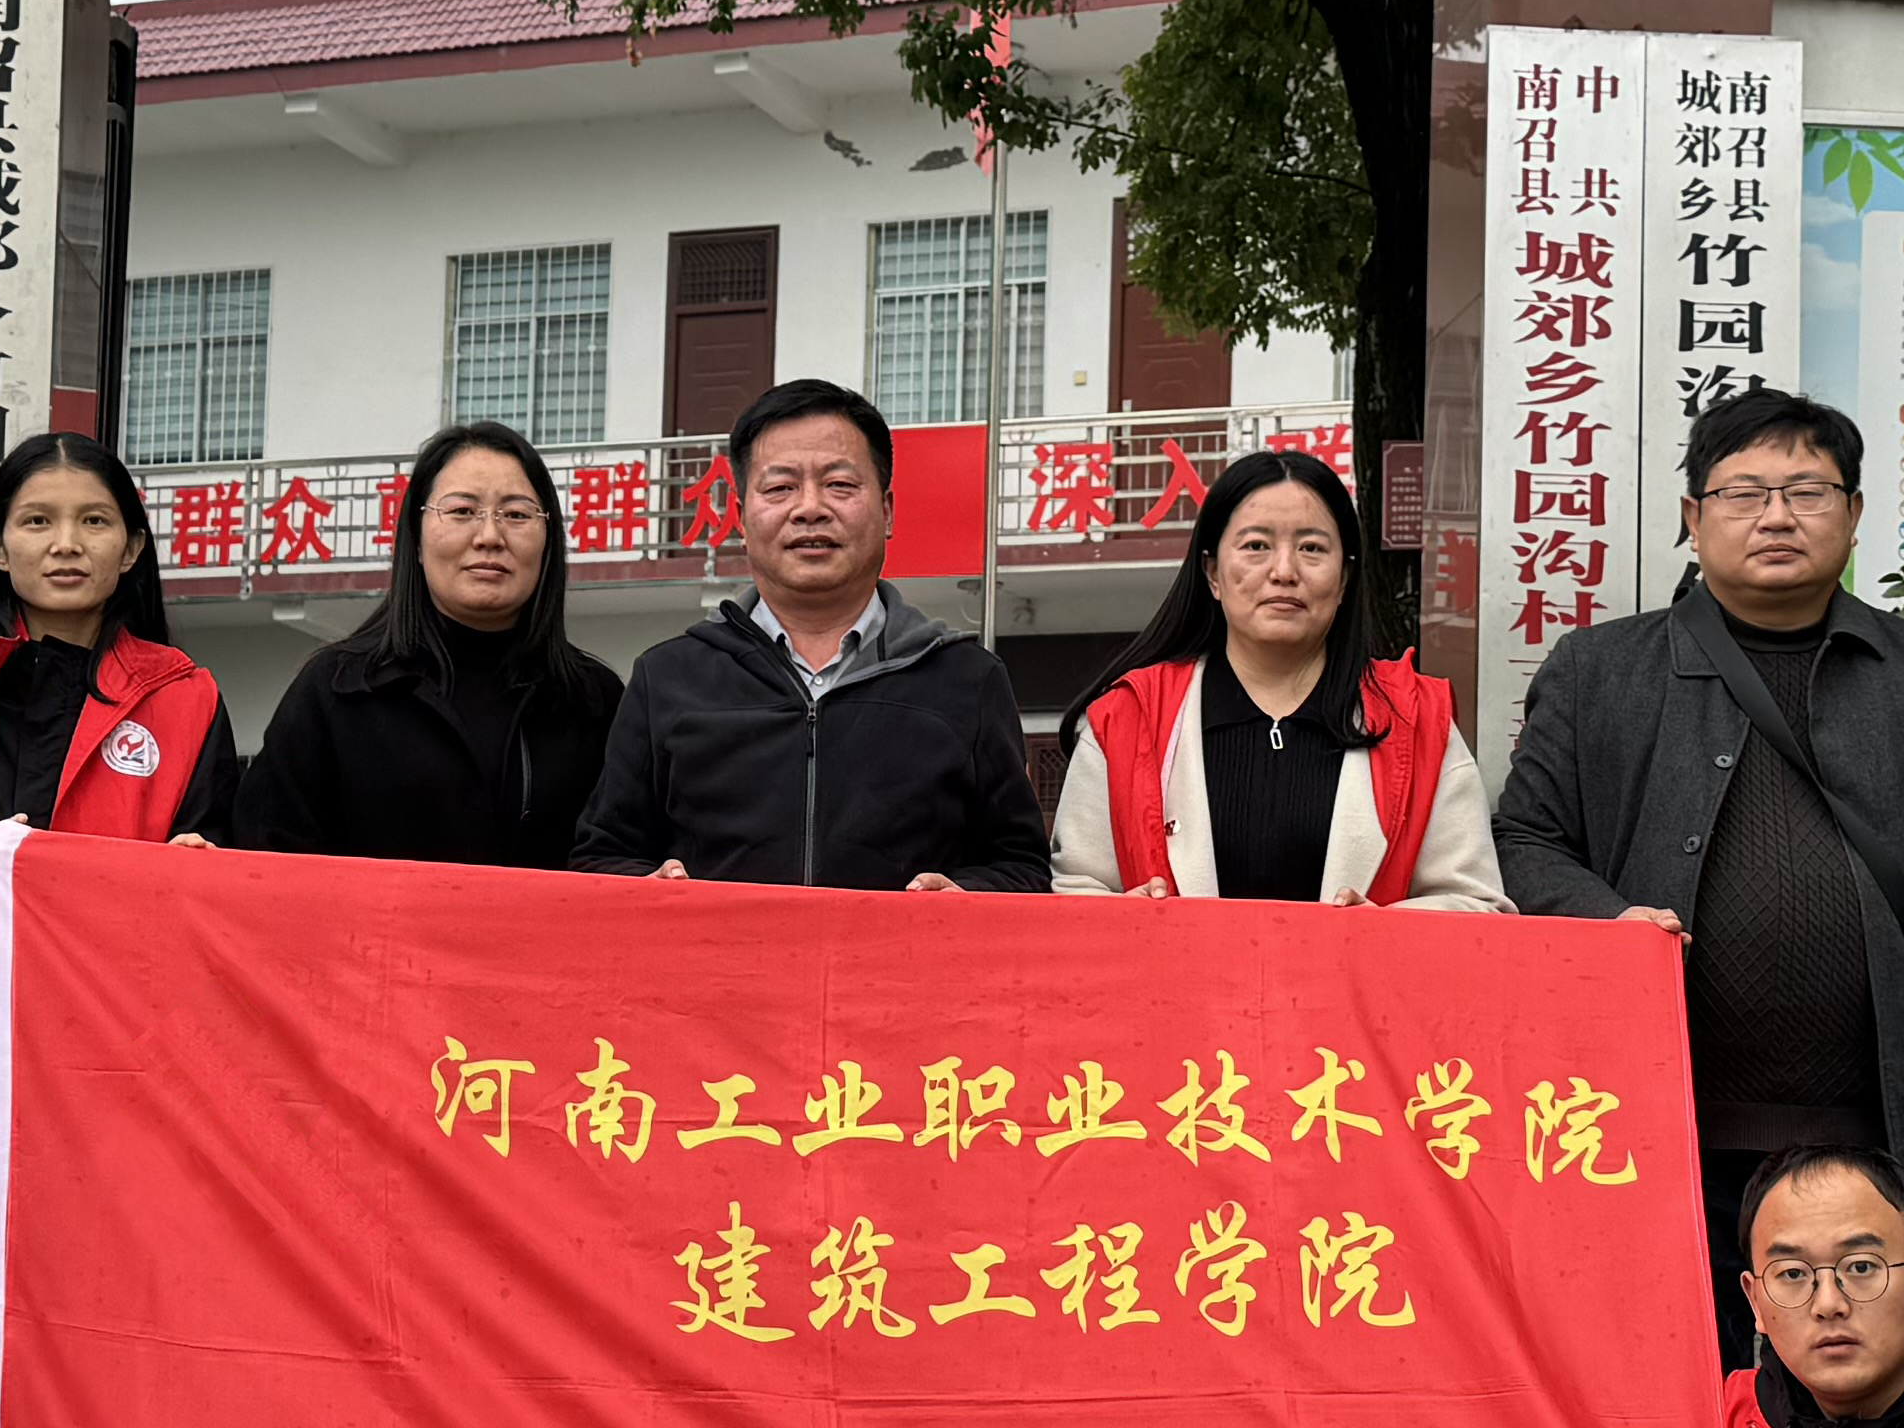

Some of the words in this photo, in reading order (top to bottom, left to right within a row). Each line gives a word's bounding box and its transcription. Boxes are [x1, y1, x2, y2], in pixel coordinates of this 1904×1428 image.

[1511, 63, 1562, 217] 南召县
[1571, 64, 1620, 219] 中共
[1675, 70, 1723, 221] 城郊乡
[1725, 70, 1771, 223] 南召县
[429, 1036, 1640, 1187] 河南工业职业技术学院
[672, 1200, 1417, 1345] 建筑工程学院
